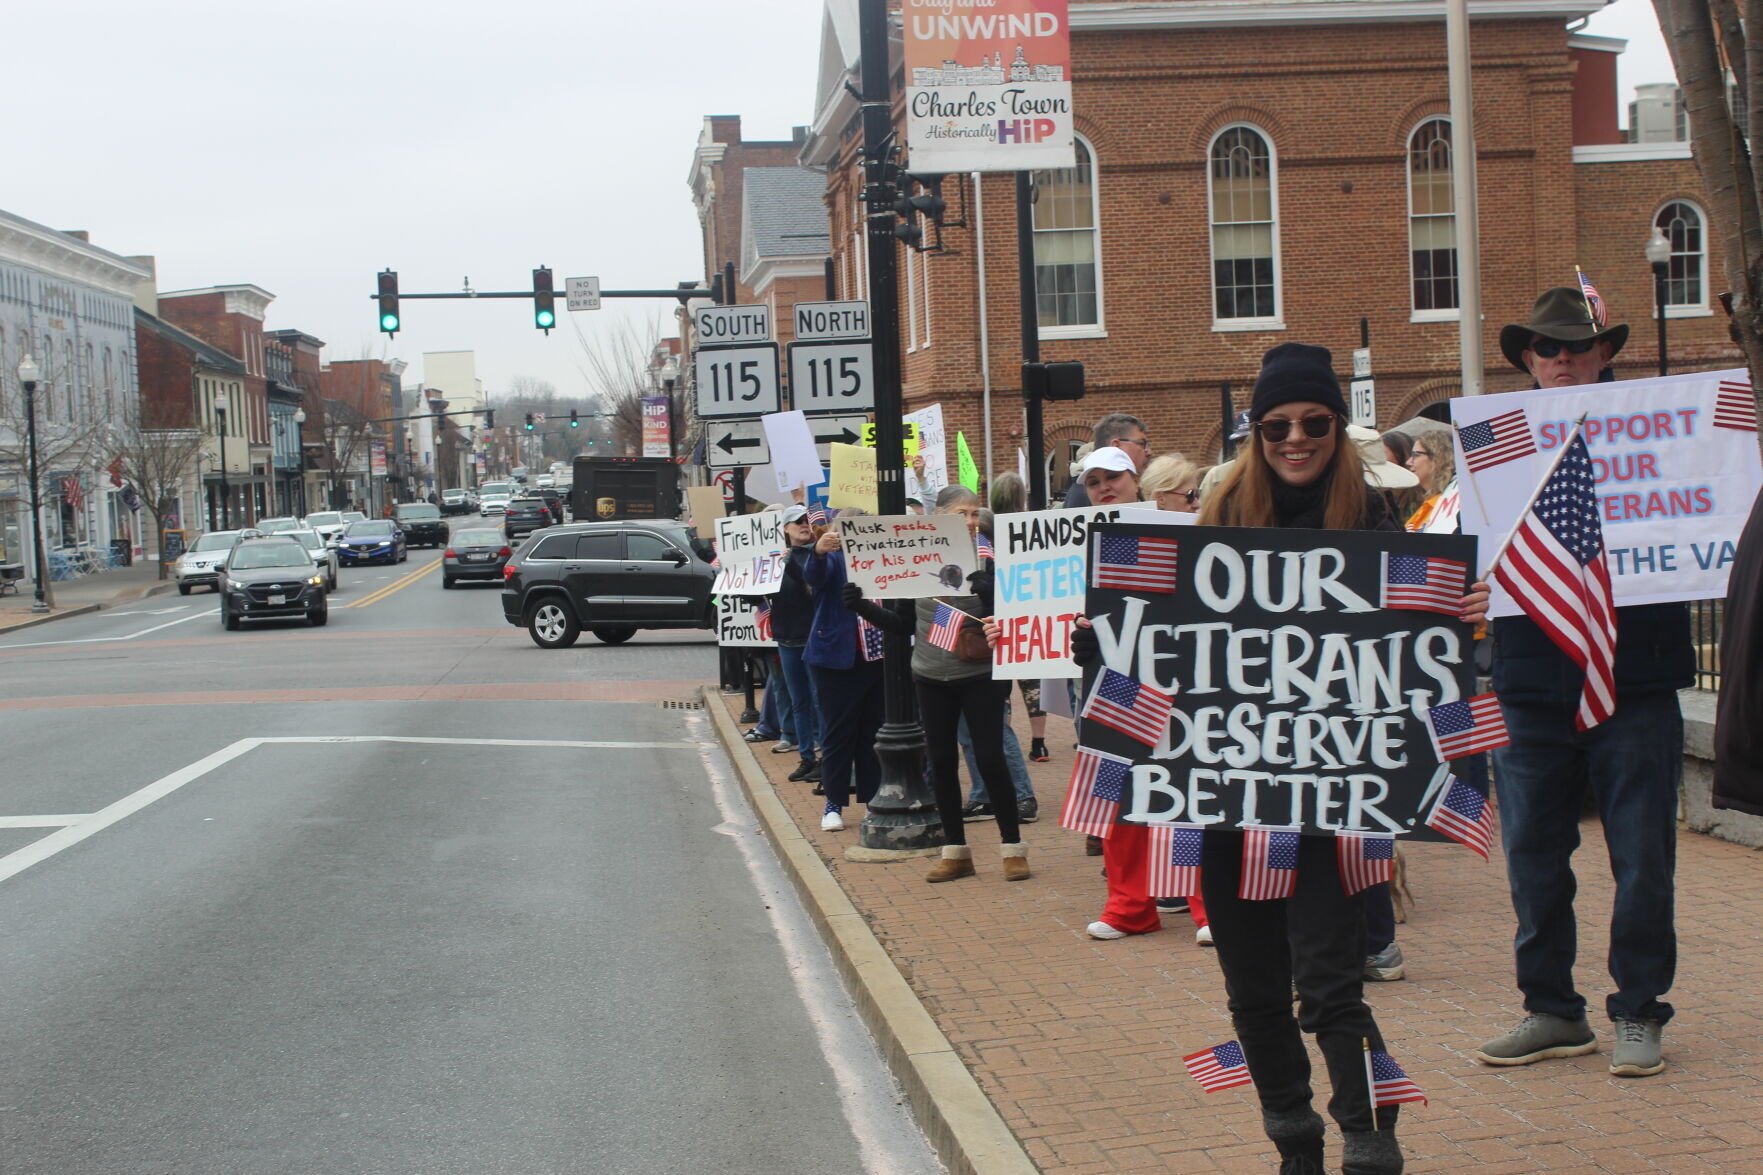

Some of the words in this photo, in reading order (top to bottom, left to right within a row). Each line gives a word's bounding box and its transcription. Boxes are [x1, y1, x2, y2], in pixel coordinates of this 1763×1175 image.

[913, 90, 996, 118] Charles
[1001, 89, 1069, 116] Town
[925, 124, 997, 142] Historically
[998, 118, 1056, 144] HiP
[701, 314, 766, 337] SOUTH
[799, 310, 865, 333] NORTH
[710, 361, 761, 402] 115
[808, 357, 861, 397] 115
[1355, 389, 1371, 418] 115
[1600, 487, 1712, 521] ERANS
[720, 520, 750, 552] Fire
[750, 513, 785, 546] Musk
[842, 520, 886, 537] Musk
[1008, 514, 1086, 555] HANDS
[845, 534, 950, 553] Privatization
[1610, 544, 1677, 576] THE
[1690, 540, 1737, 571] VA
[851, 555, 873, 573] for
[882, 553, 905, 567] his
[912, 552, 942, 566] own
[719, 564, 748, 591] Not
[874, 569, 921, 590] agenda
[996, 554, 1085, 603] VETER
[1194, 542, 1382, 614] OUR
[721, 594, 754, 613] STE
[721, 616, 758, 641] From
[996, 613, 1080, 666] HEALT
[1090, 596, 1463, 722] VETERANS
[1149, 702, 1408, 769] DESERVE
